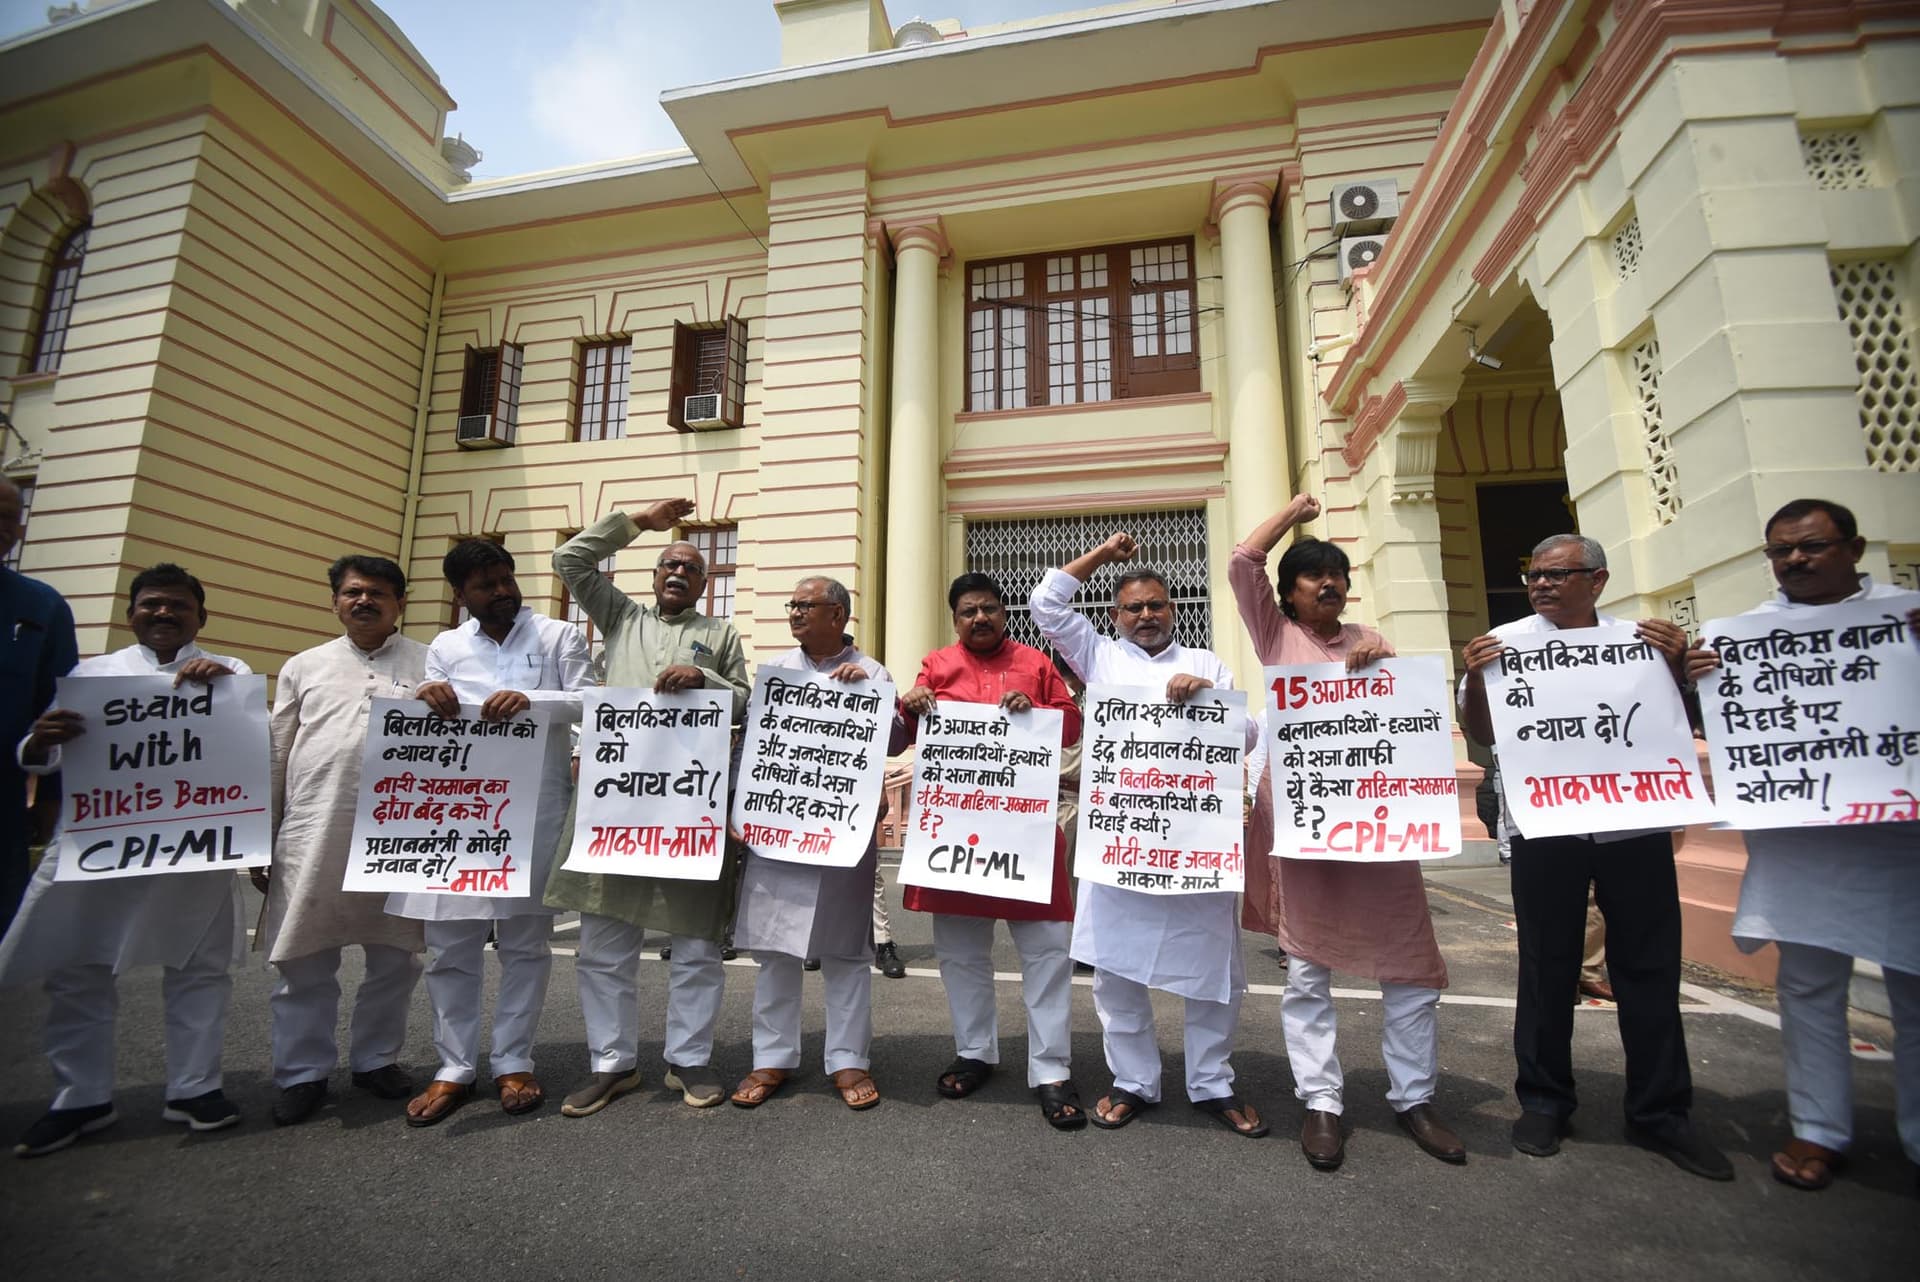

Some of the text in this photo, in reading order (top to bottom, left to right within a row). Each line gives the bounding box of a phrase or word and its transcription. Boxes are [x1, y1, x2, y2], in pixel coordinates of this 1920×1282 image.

[1711, 614, 1907, 668] बिलकिस बानो
[1500, 640, 1598, 676] बिलकिस
[1271, 669, 1395, 710] 15 अगस्त को
[1718, 655, 1879, 697] के दोषियों की
[764, 677, 882, 714] बिलकिस बानो
[1506, 678, 1534, 708] को
[384, 710, 470, 737] बिलकिस
[511, 718, 538, 739] को
[595, 701, 723, 731] बिलकिस बानो
[760, 706, 877, 743] के बलात्कारियों
[925, 715, 1010, 737] 15 अगस्त को
[1094, 699, 1138, 727] दलित
[1186, 700, 1229, 724] बच्चे
[1721, 695, 1842, 734] रिहाई पर
[1517, 717, 1587, 741] न्याय
[383, 745, 438, 762] न्याय
[596, 732, 629, 763] को
[758, 734, 868, 770] और जनसंहार के
[1092, 732, 1240, 766] इंद्र मेघवाल की हत्या
[1283, 740, 1396, 768] को सजा माफी
[1726, 727, 1868, 771] प्रधानमंत्री
[374, 772, 510, 795] नारी सम्मान का
[594, 772, 670, 798] न्याय
[752, 759, 857, 795] दोषियों को सजा
[922, 762, 1016, 787] को सजा माफी
[1092, 765, 1217, 792] और बिलकिस बानो
[1287, 772, 1306, 799] ये
[1309, 772, 1354, 798] कैसा
[1357, 771, 1411, 799] महिला
[71, 782, 163, 823] Bilkis
[373, 796, 414, 824] ढोंग
[413, 797, 448, 824] बंद
[744, 789, 787, 814] माफी
[786, 796, 808, 820] रद्द
[918, 785, 930, 808] ये
[929, 784, 960, 807] कैसा
[1091, 786, 1222, 813] के बलात्कारियों की
[1088, 809, 1128, 833] रिहाई
[78, 826, 243, 873] CPI-ML
[366, 830, 511, 856] प्रधानमंत्री मोदी
[364, 858, 421, 874] जवाब
[1185, 851, 1222, 869] जवाब
